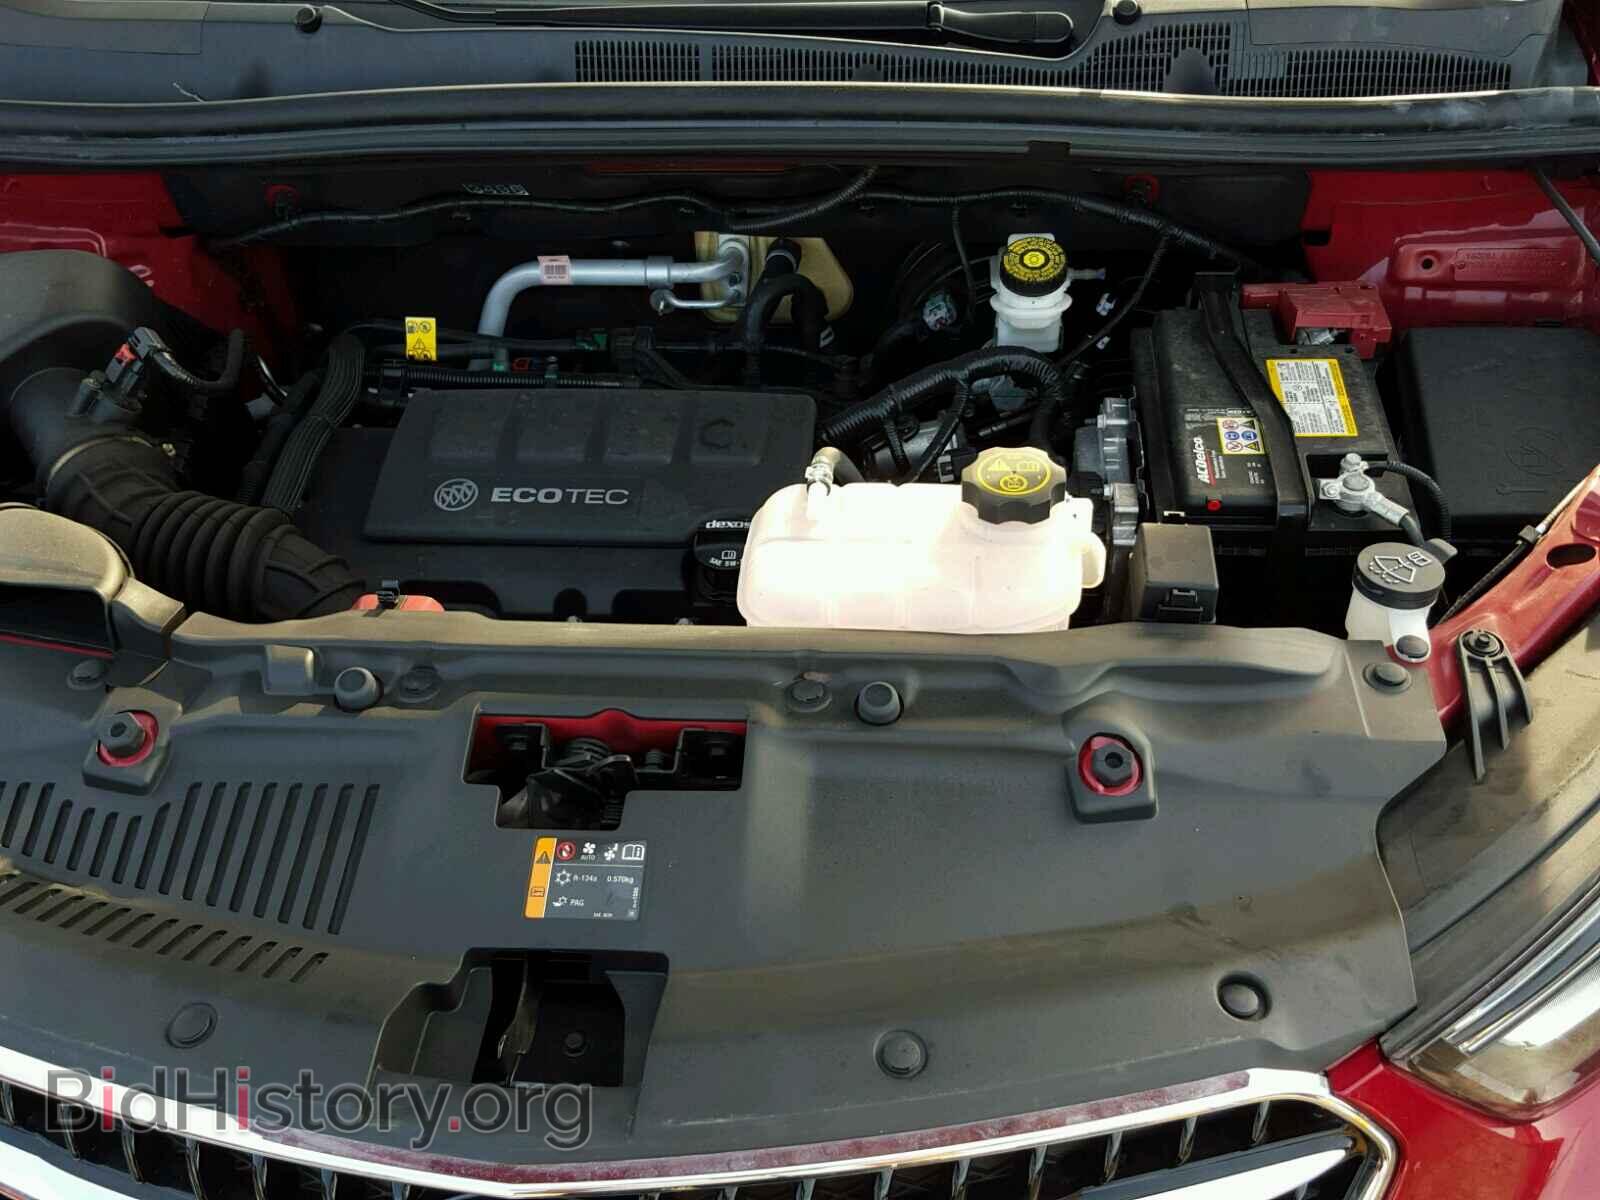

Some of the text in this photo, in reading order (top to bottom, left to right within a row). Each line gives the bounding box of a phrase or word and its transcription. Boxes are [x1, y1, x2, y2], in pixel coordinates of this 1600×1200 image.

[1193, 437, 1210, 484] ACDelco
[490, 487, 630, 505] ECOTEC
[569, 898, 585, 907] PAG
